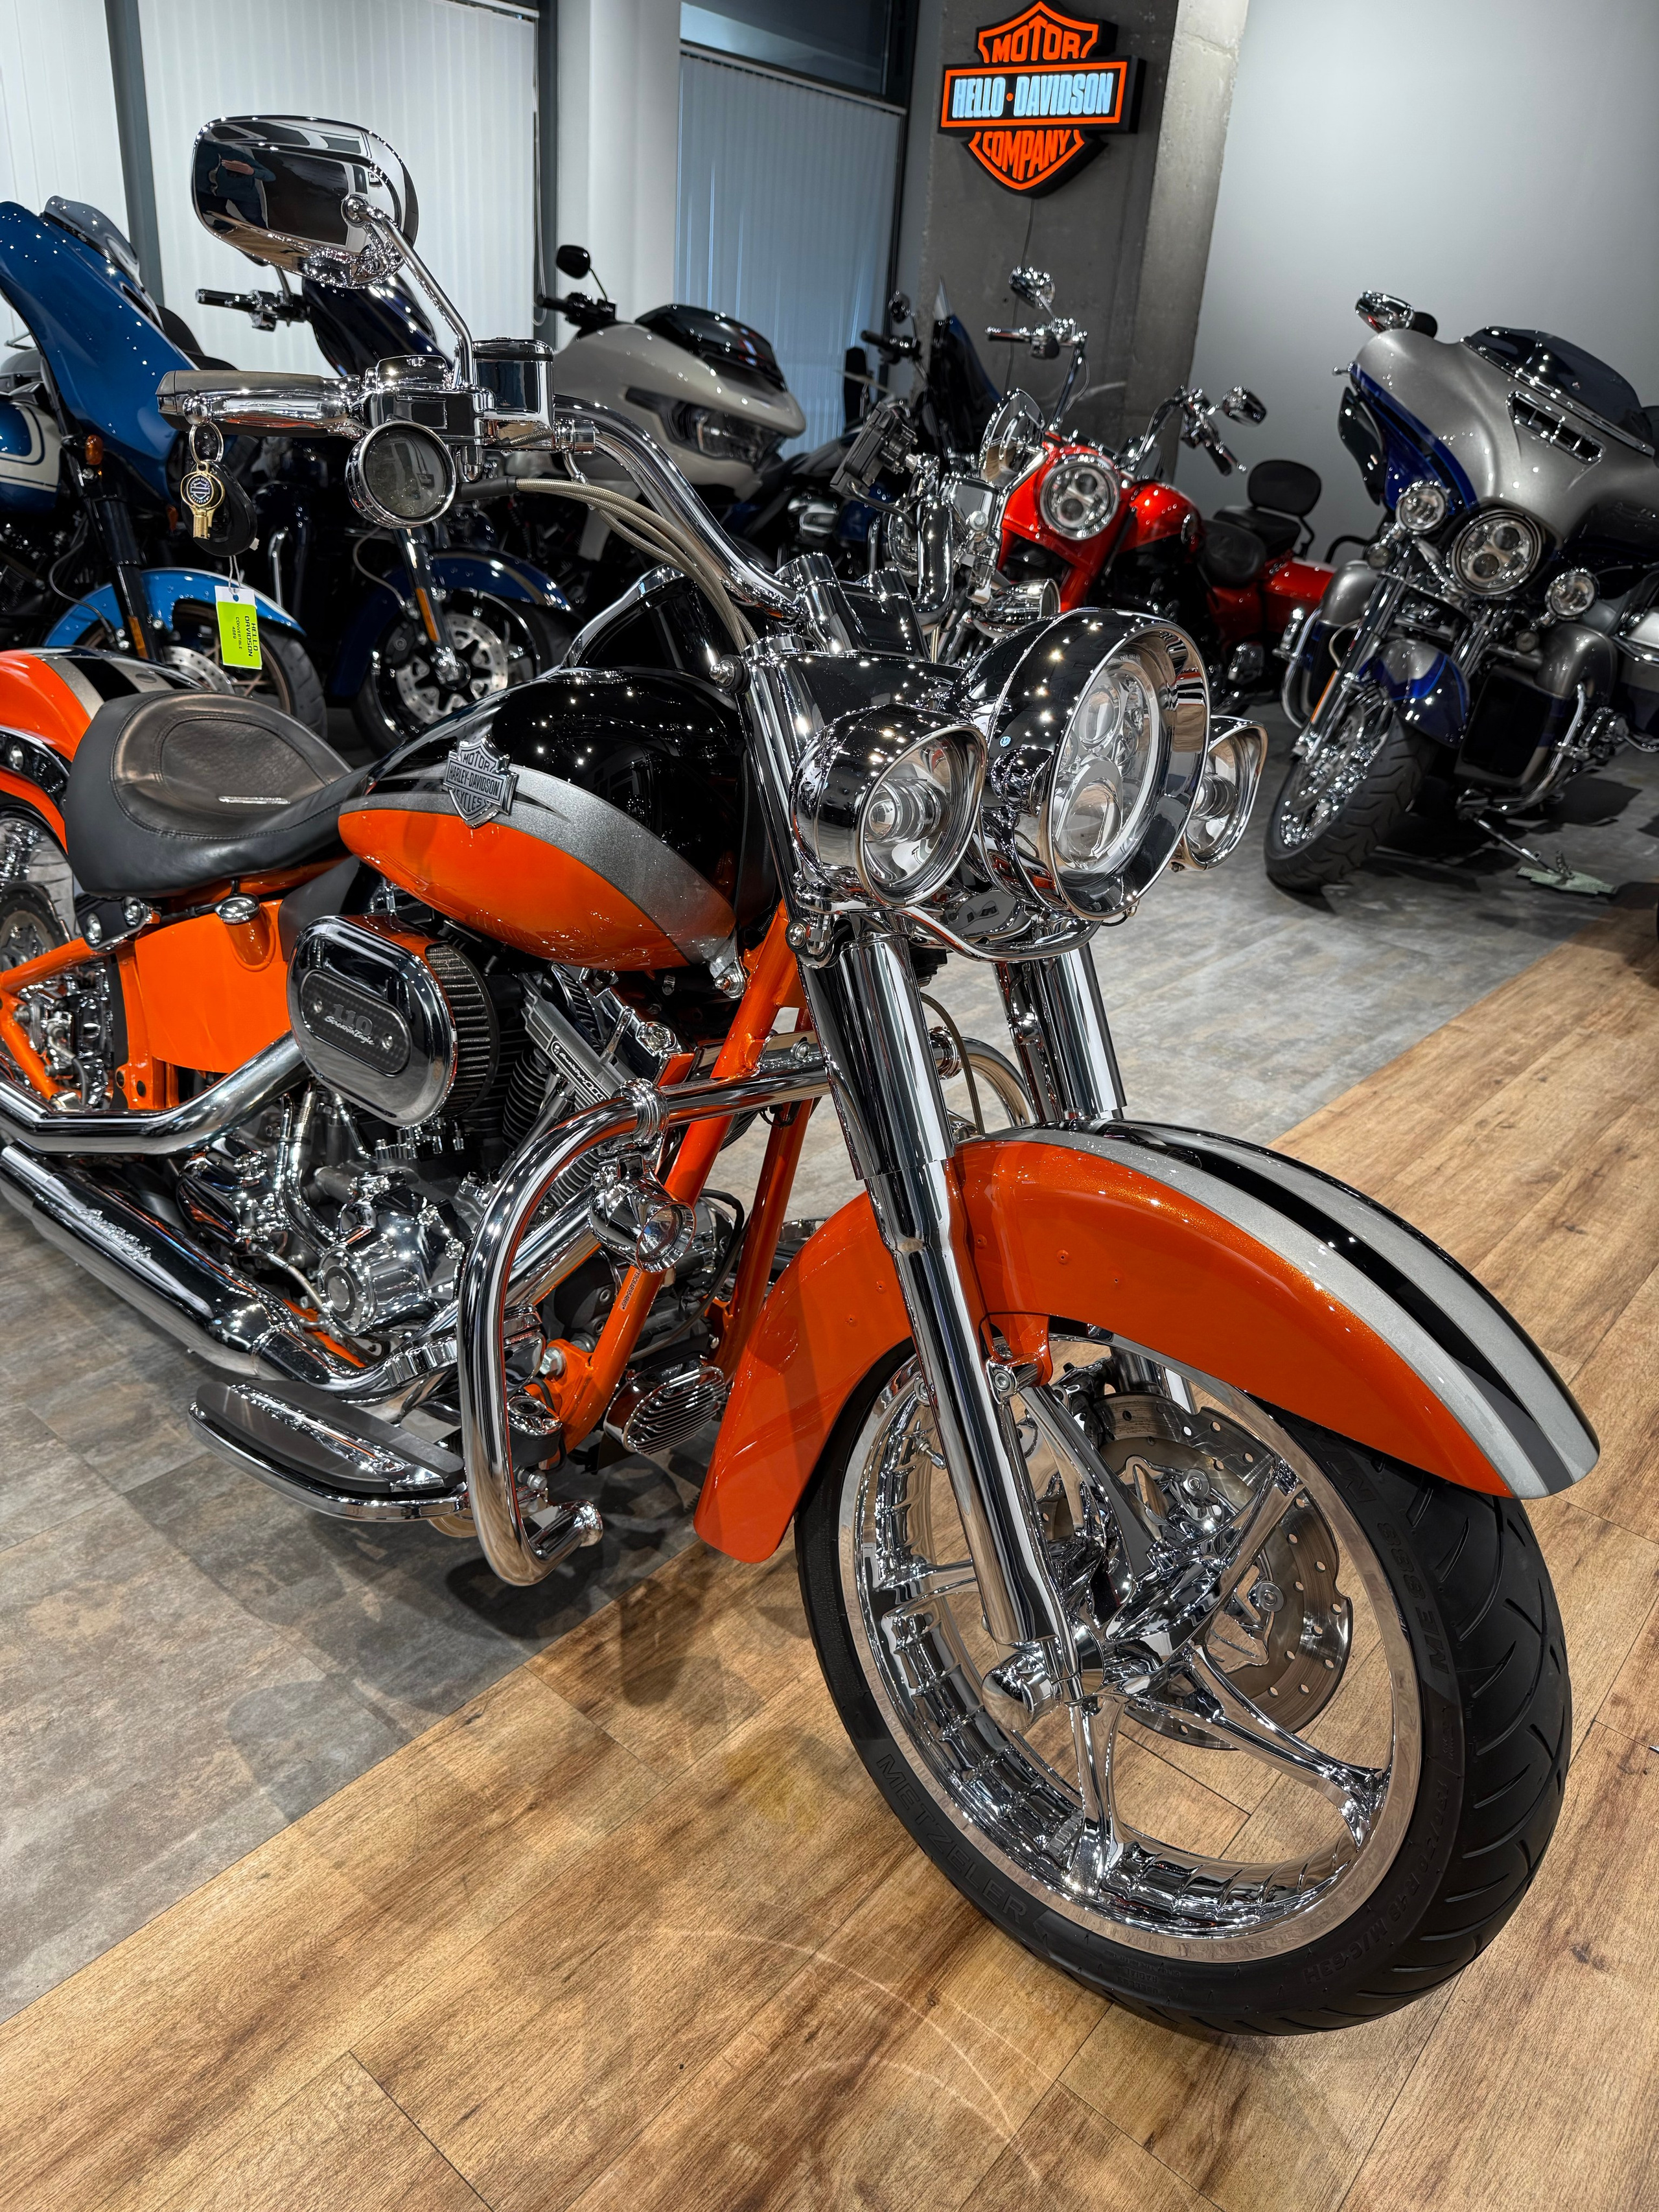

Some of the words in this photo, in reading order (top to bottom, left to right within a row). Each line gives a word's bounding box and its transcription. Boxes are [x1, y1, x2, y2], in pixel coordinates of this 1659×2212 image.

[992, 16, 1082, 63] MOTOR
[952, 76, 1006, 119] HELLO
[1014, 73, 1115, 117] DAVIDSON
[982, 130, 1072, 181] COMPANY
[244, 616, 253, 657] DAVIDSON
[448, 765, 500, 797] HARLEY-DAVIDSON
[463, 749, 491, 772] MOTOR
[456, 789, 483, 812] CYCLES
[332, 1004, 373, 1036] 110
[354, 1029, 375, 1045] Eagle
[1378, 1522, 1425, 1600] 888
[1415, 1607, 1451, 1675] ME
[876, 1753, 1028, 1923] METZELER
